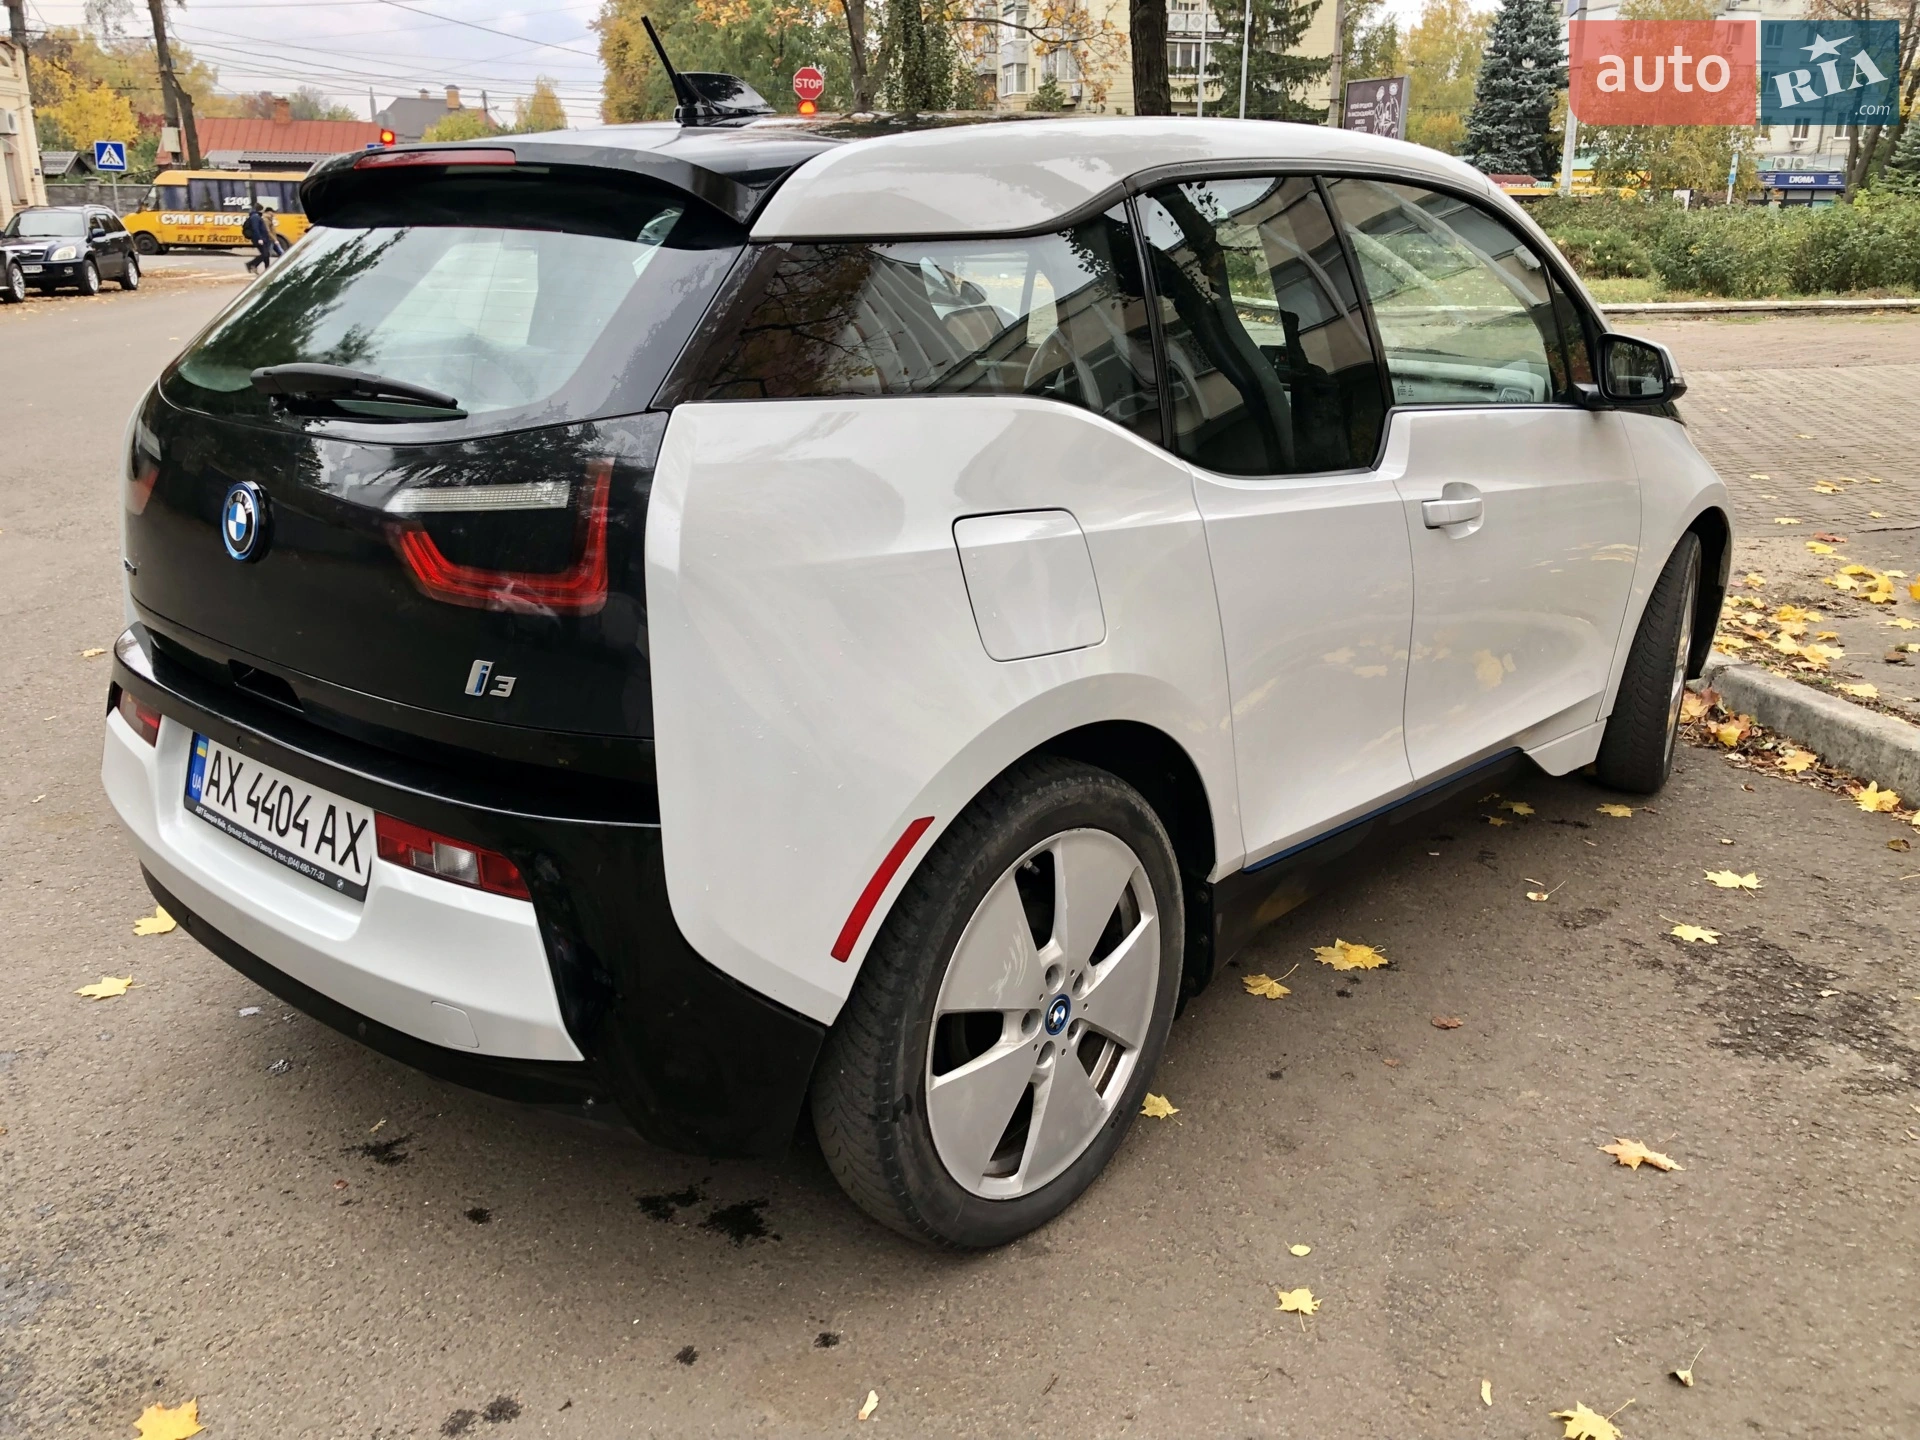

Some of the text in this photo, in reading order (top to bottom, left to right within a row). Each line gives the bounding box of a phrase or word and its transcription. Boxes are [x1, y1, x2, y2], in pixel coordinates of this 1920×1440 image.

[795, 78, 822, 89] STOP
[464, 659, 518, 698] i3
[192, 773, 201, 791] UA
[205, 750, 369, 875] AX 4404 AX
